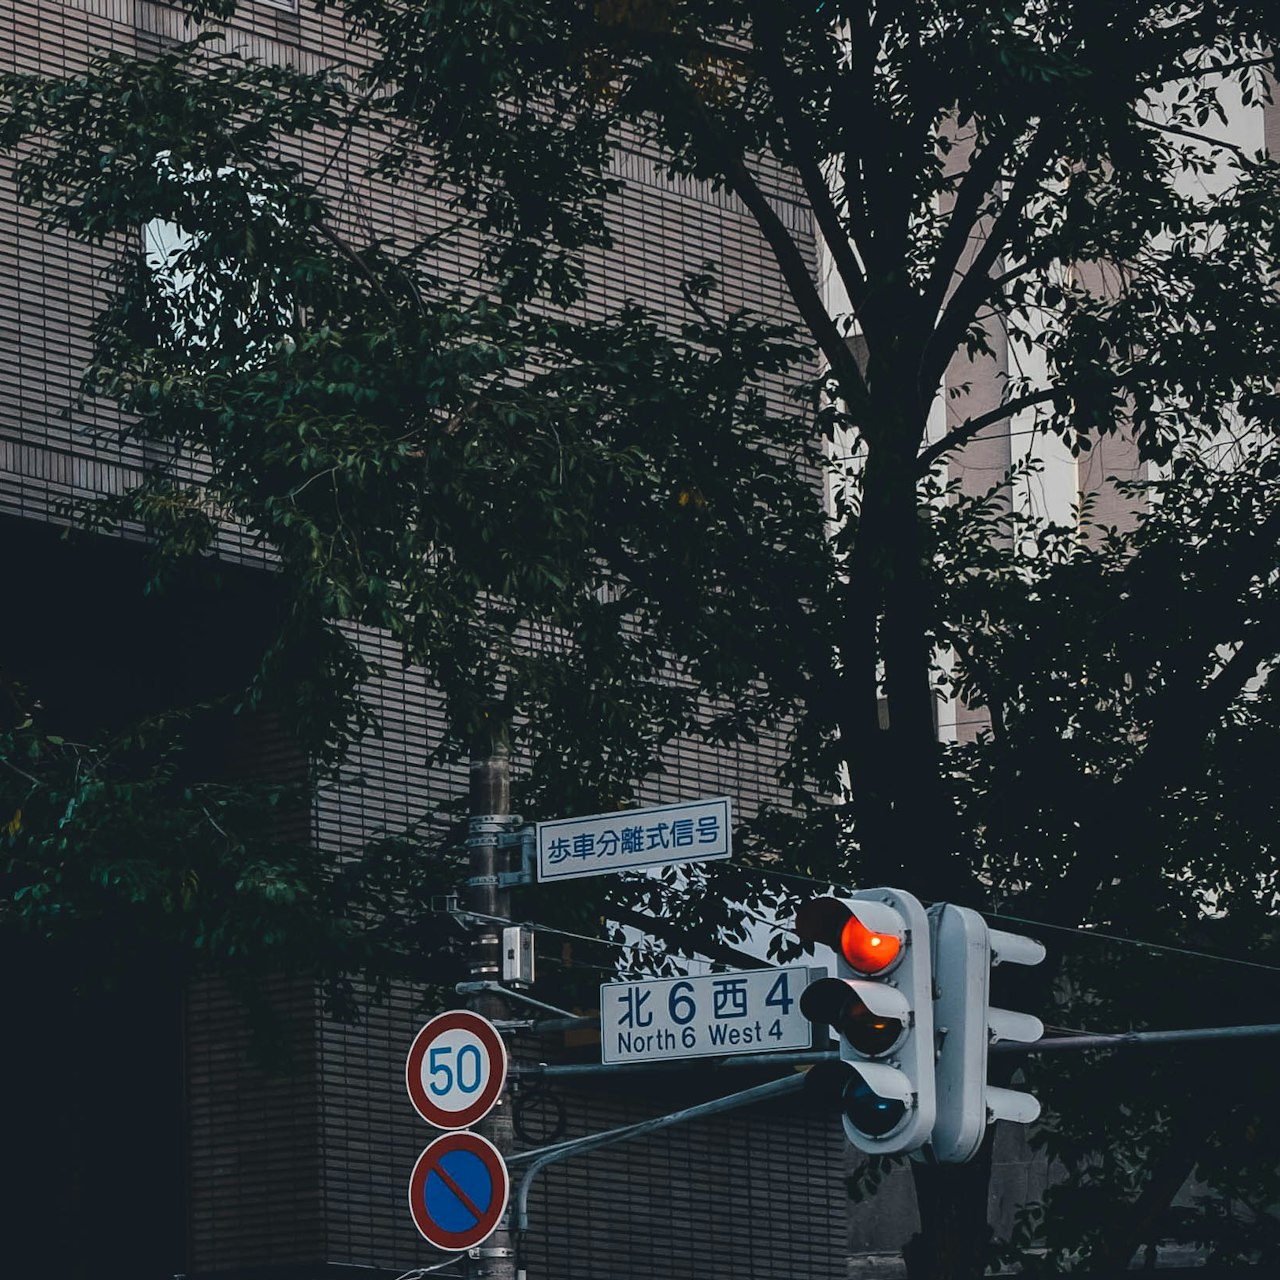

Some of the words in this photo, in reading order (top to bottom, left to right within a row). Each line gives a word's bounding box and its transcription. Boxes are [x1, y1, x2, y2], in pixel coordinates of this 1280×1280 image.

[548, 815, 720, 865] 歩車分離式信号
[618, 1028, 676, 1054] North
[682, 1026, 697, 1049] 6
[709, 1020, 762, 1046] West
[768, 1019, 784, 1041] 4
[429, 1044, 482, 1096] 50
